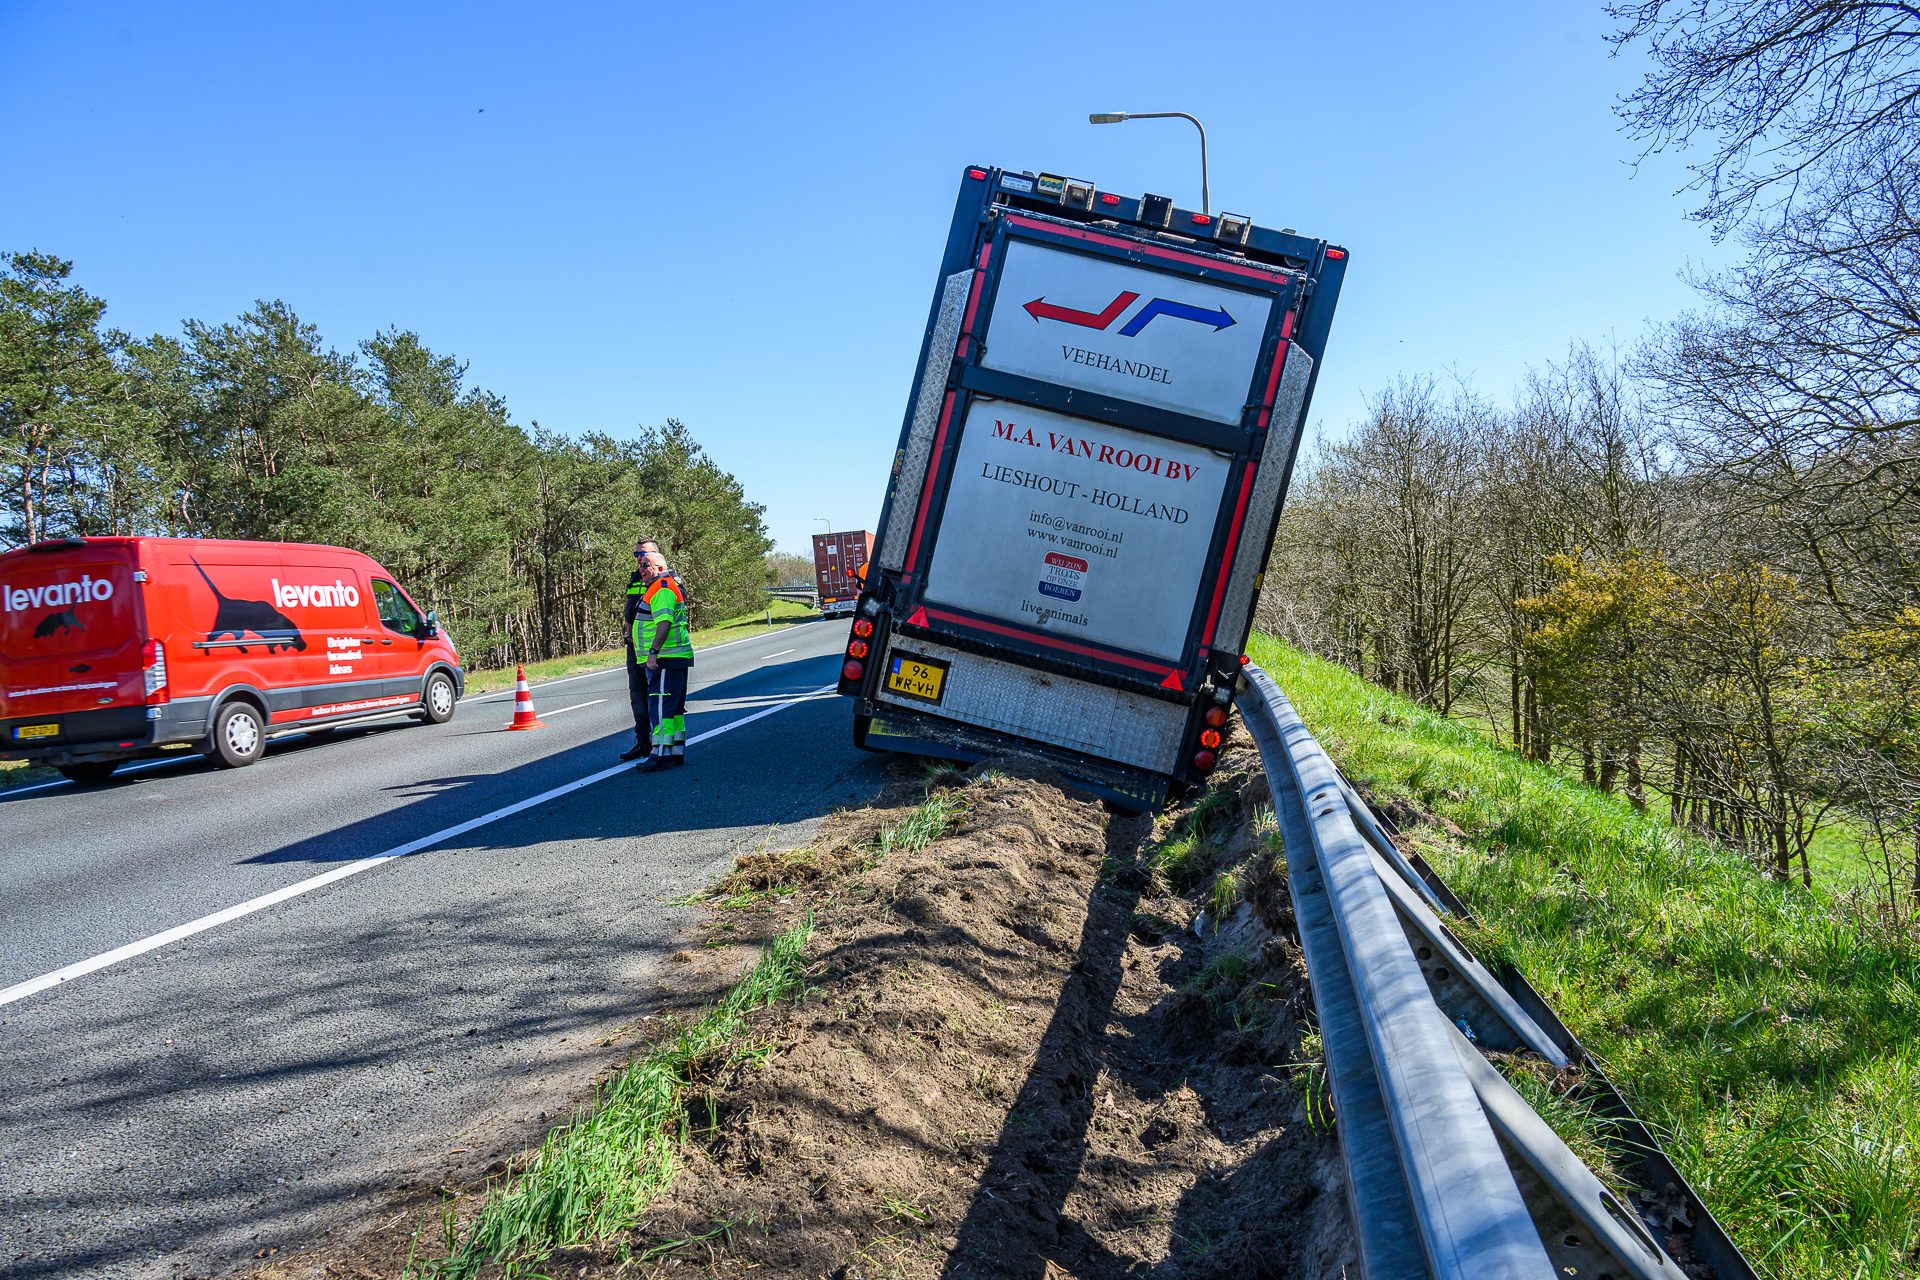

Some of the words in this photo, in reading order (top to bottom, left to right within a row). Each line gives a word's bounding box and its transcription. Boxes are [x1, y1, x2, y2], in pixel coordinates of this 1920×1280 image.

[1061, 345, 1173, 385] VEEHANDEL
[991, 419, 1041, 448] M.A.
[1048, 432, 1096, 459] VAN
[1097, 444, 1163, 475] ROOI
[1164, 460, 1200, 482] BV
[981, 462, 1080, 498] LIESHOUT
[1091, 488, 1189, 524] HOLLAND
[1029, 509, 1124, 544] info@vanrooi.nl
[1027, 528, 1118, 559] www.vanrooi.nl
[1048, 566, 1081, 580] TROTS
[1057, 577, 1078, 588] ONZE
[4, 574, 114, 611] levanto
[271, 578, 359, 608] levanto
[1044, 583, 1076, 597] BOEREN
[1020, 599, 1042, 614] live
[326, 637, 362, 650] Brighter
[329, 664, 353, 675] ideas
[912, 665, 928, 679] 96
[895, 675, 935, 696] WR-VH
